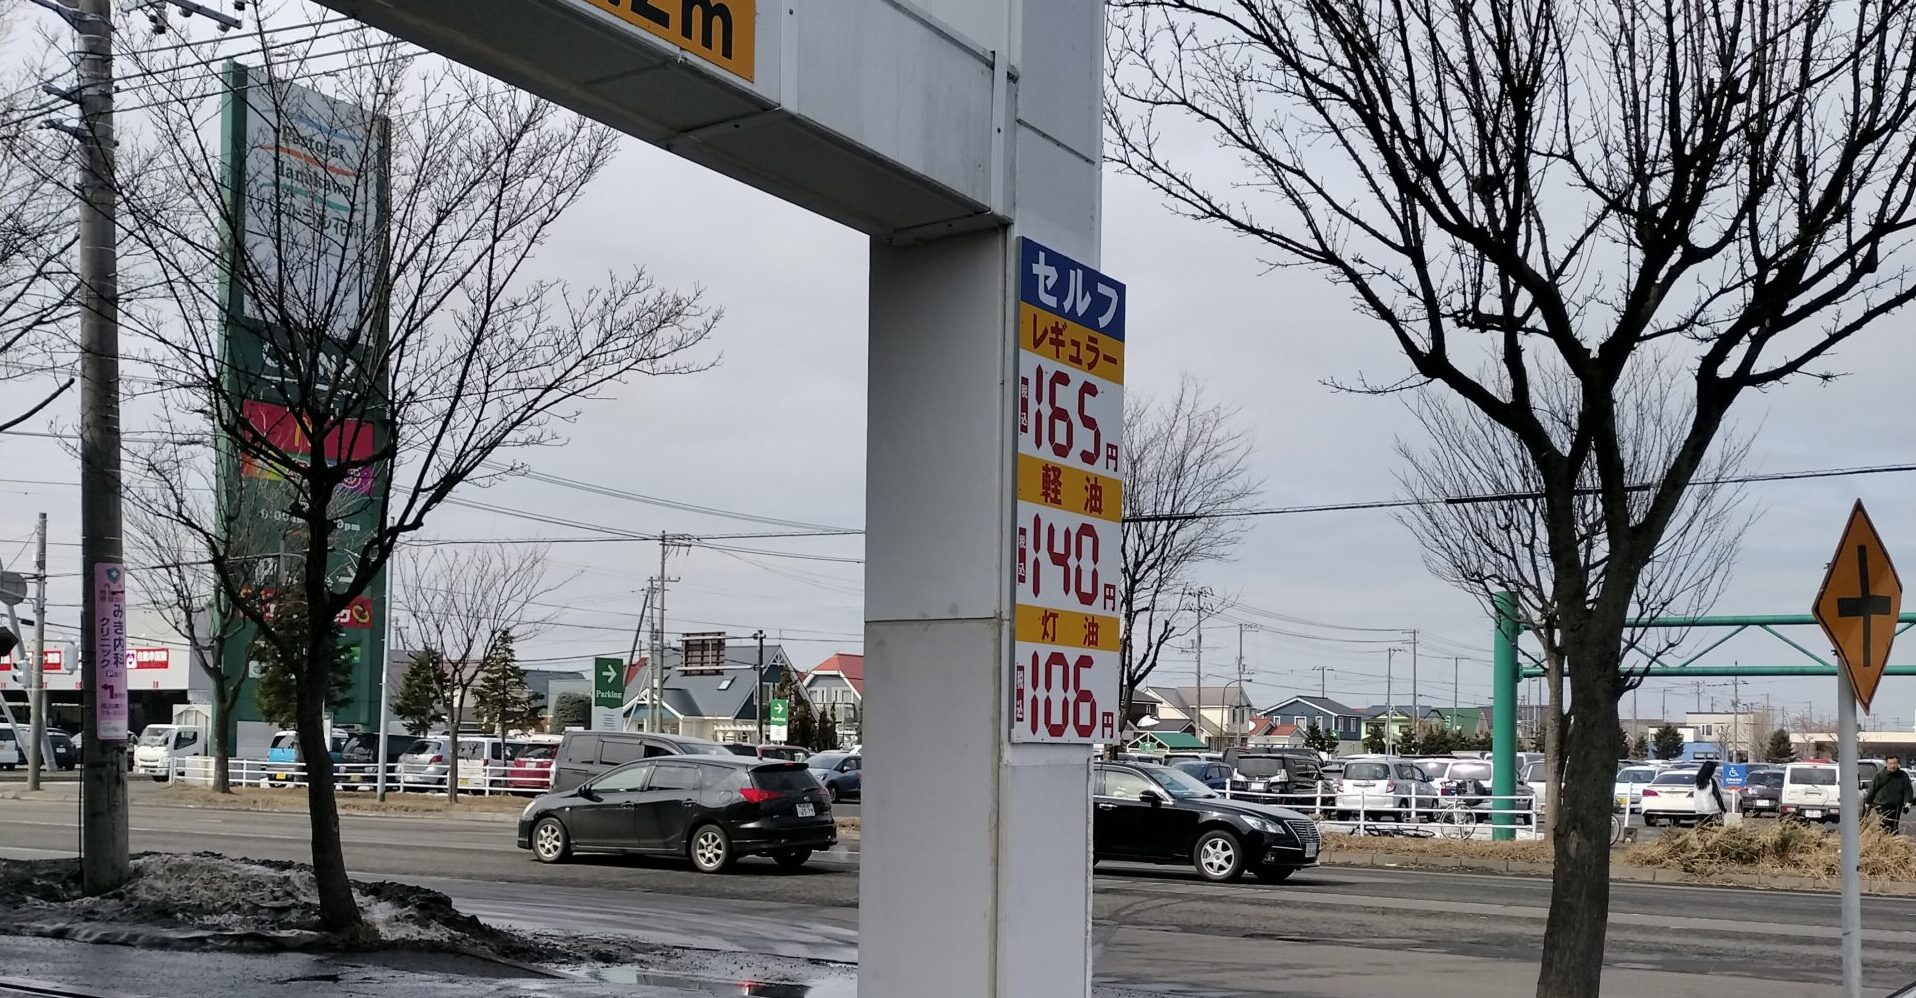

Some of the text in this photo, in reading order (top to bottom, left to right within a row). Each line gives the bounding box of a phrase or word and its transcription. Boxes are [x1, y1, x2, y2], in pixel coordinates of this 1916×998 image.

[1032, 250, 1118, 328] セルフ
[1033, 313, 1118, 371] レギュラー
[1040, 464, 1103, 515] 軽油
[100, 616, 111, 669] クリニック
[112, 603, 124, 668] みき内科
[1041, 610, 1099, 647] 灯油
[596, 689, 623, 699] Parking
